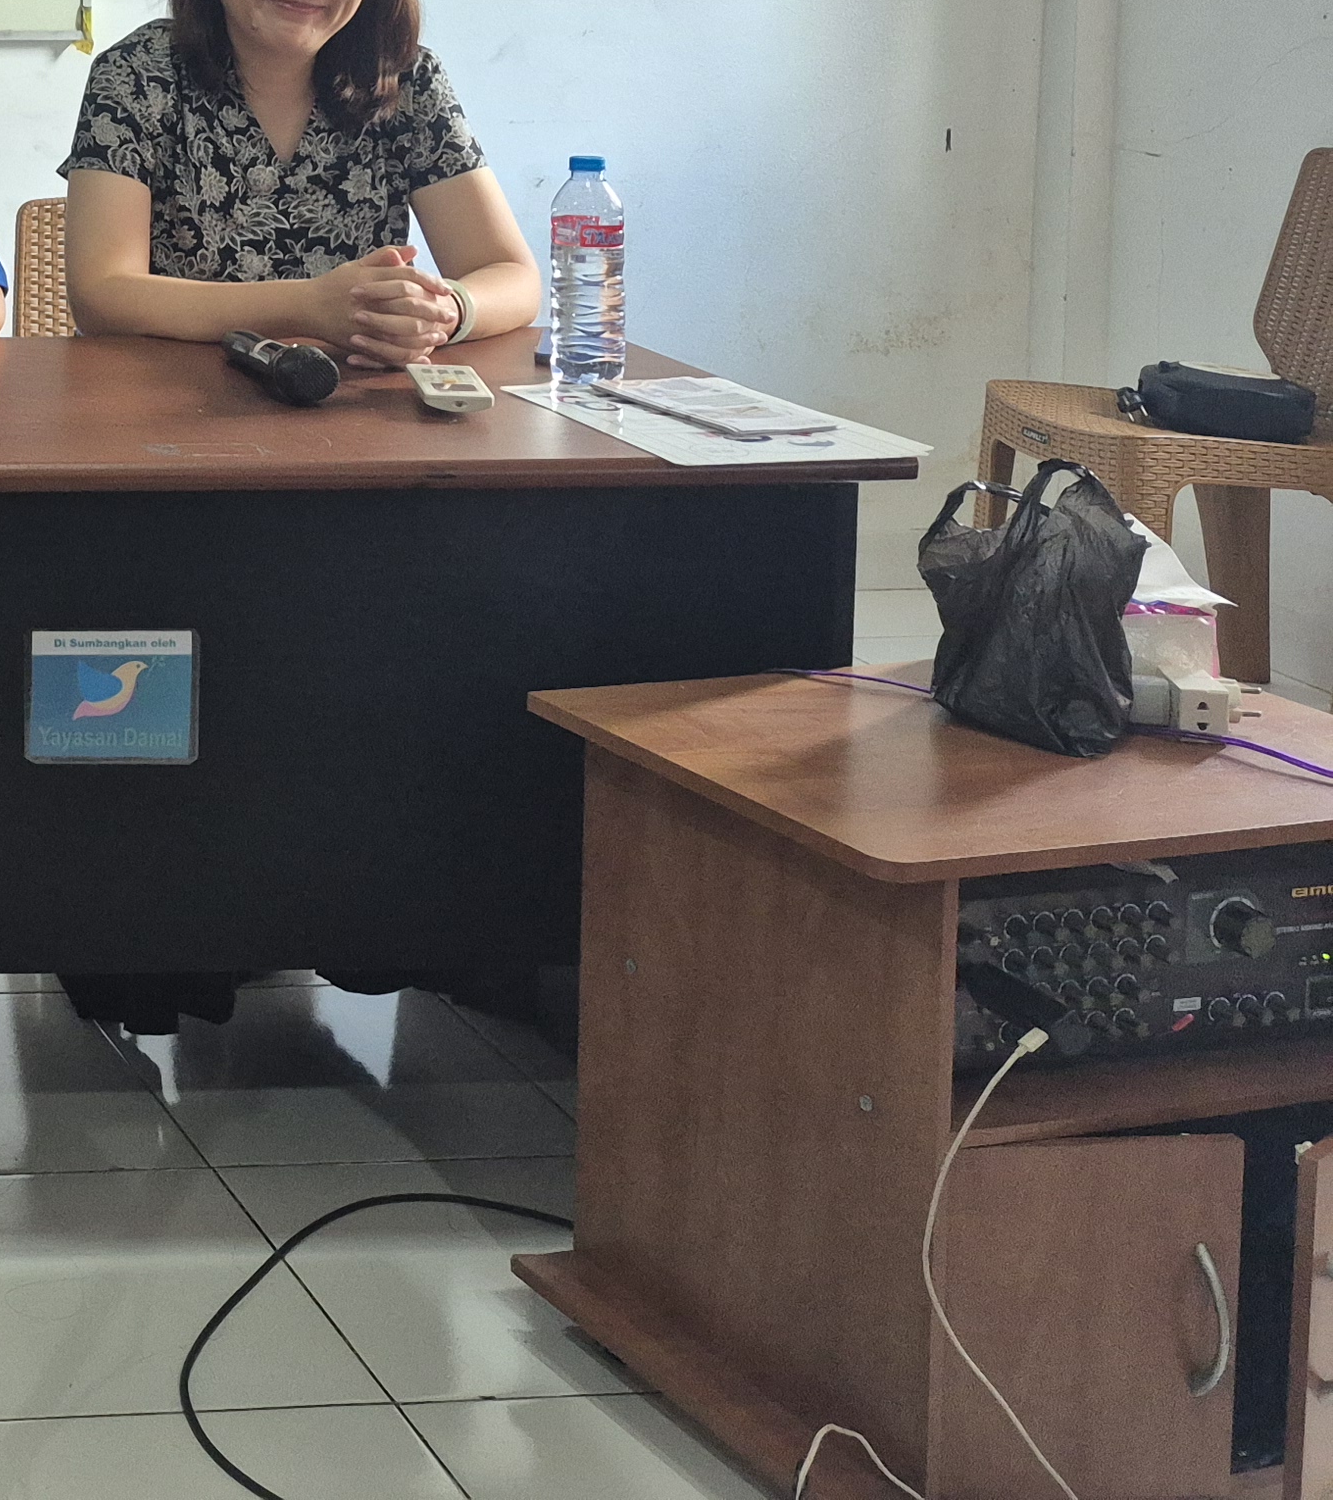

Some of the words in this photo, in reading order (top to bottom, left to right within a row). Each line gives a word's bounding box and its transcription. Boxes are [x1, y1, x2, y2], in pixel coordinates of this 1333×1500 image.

[54, 638, 66, 648] Di
[70, 638, 147, 650] Sumbangkan
[151, 638, 176, 648] oleh
[38, 726, 117, 750] Yayasan
[124, 728, 183, 747] Damai
